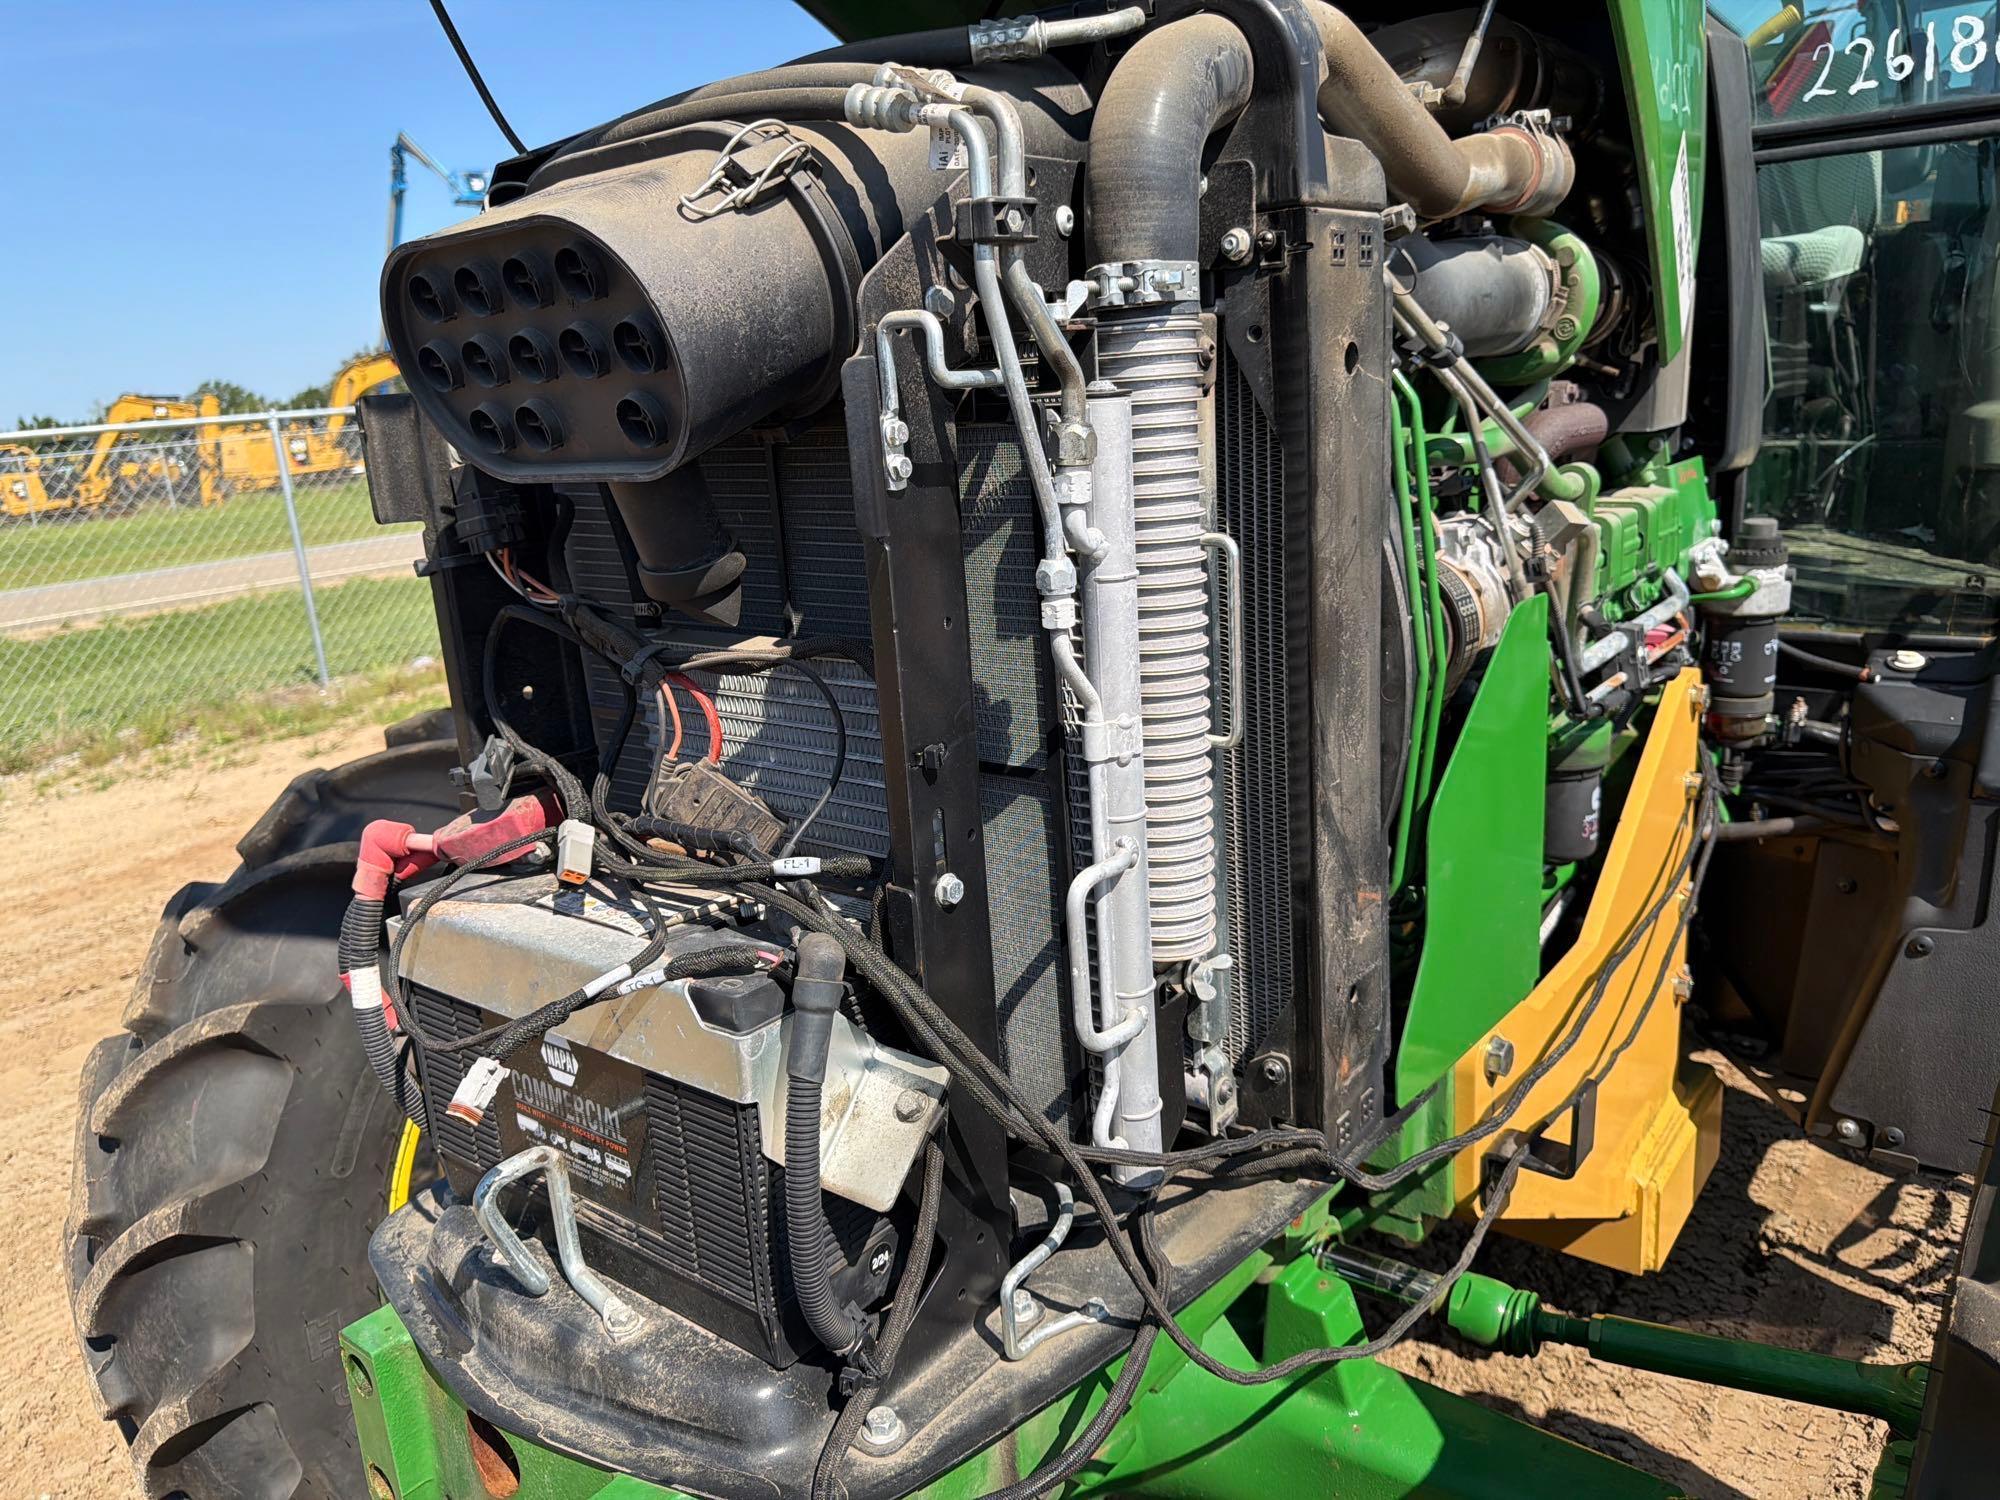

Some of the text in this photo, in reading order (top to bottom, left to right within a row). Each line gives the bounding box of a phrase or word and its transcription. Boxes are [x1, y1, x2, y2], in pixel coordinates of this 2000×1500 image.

[1802, 15, 2000, 102] 22618
[784, 858, 809, 869] FL-1
[547, 1043, 575, 1075] NAPA
[511, 1069, 628, 1143] COMMERCIAL
[605, 1140, 628, 1154] POWER
